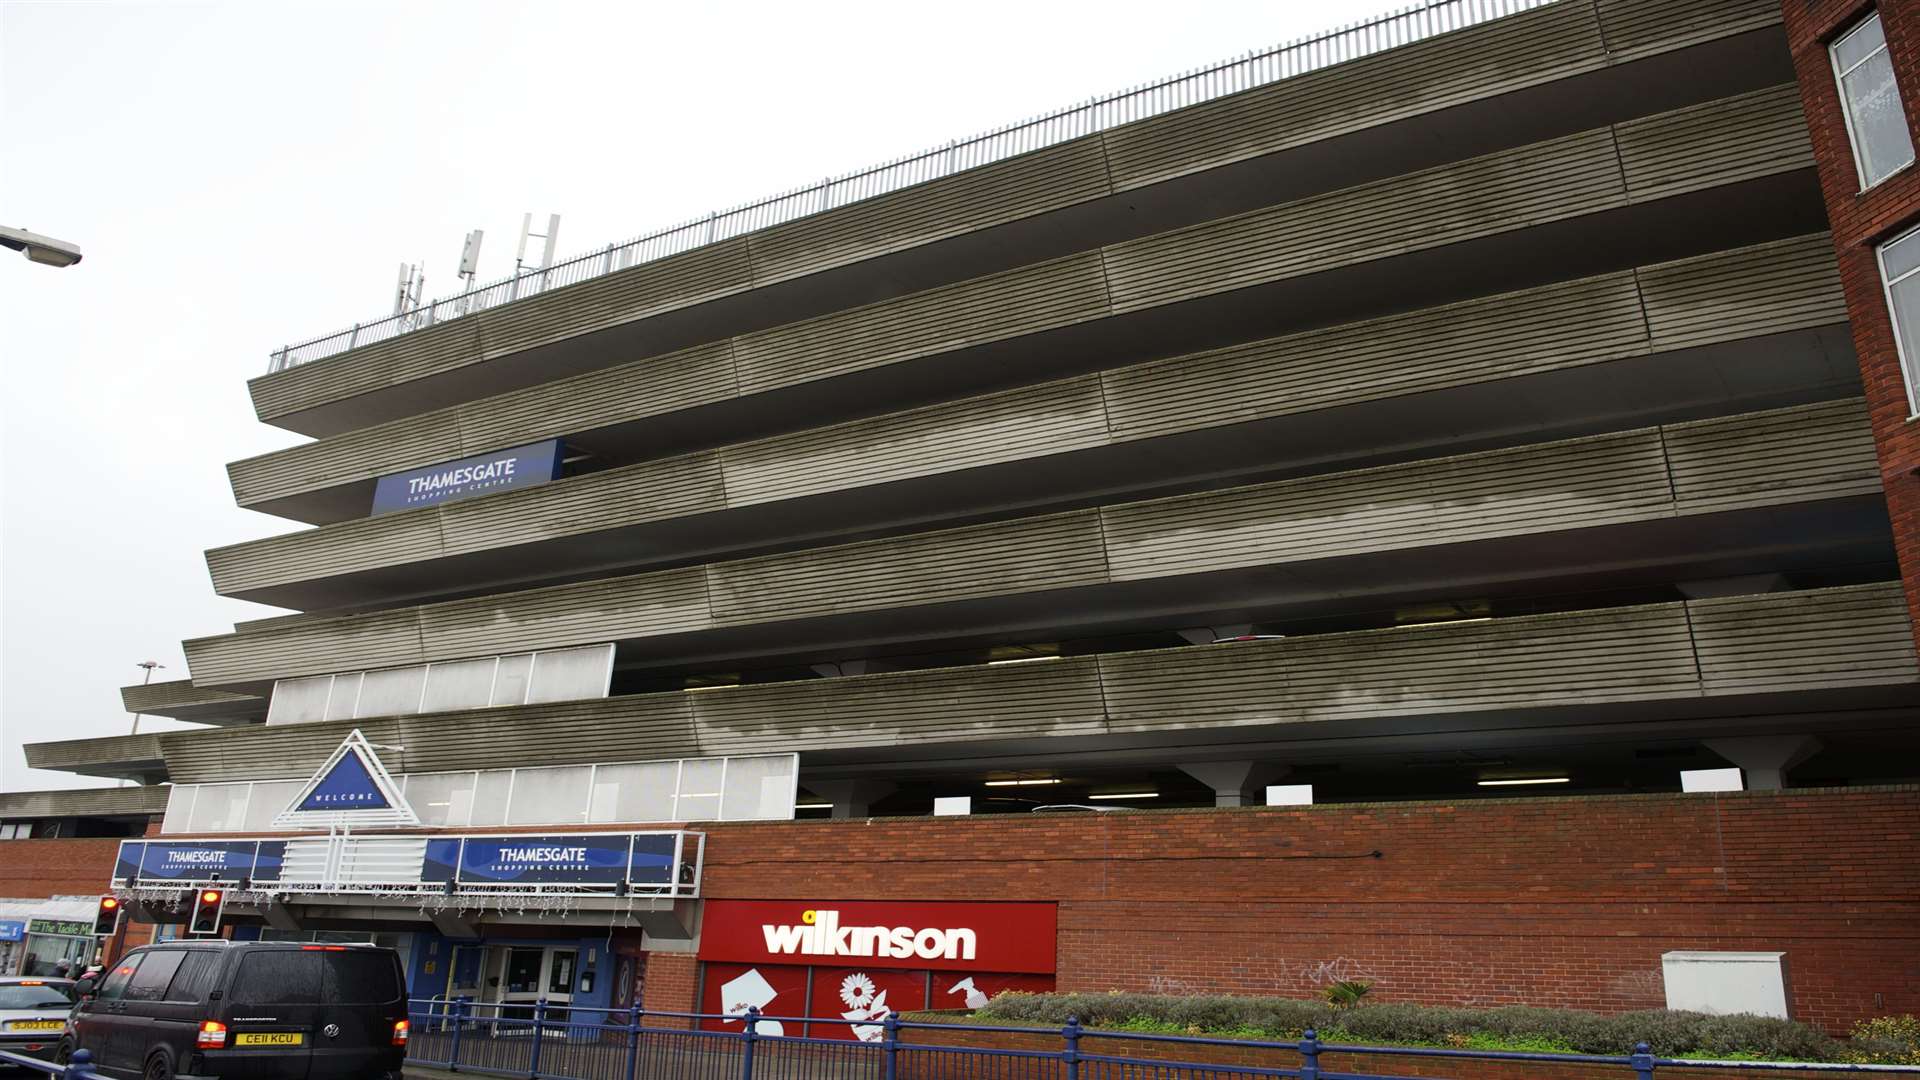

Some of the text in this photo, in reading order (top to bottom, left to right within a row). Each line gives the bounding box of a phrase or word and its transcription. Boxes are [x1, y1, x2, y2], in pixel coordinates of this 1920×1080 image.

[408, 458, 517, 494] THAMESGATE
[407, 477, 512, 503] SHOPPING CENTRE
[315, 793, 373, 801] WELCOME
[168, 851, 226, 862] THAMESGATE
[499, 847, 587, 862] THAMESGATE
[41, 921, 54, 933] The
[762, 910, 976, 960] wilkinson
[270, 1034, 294, 1044] KCU
